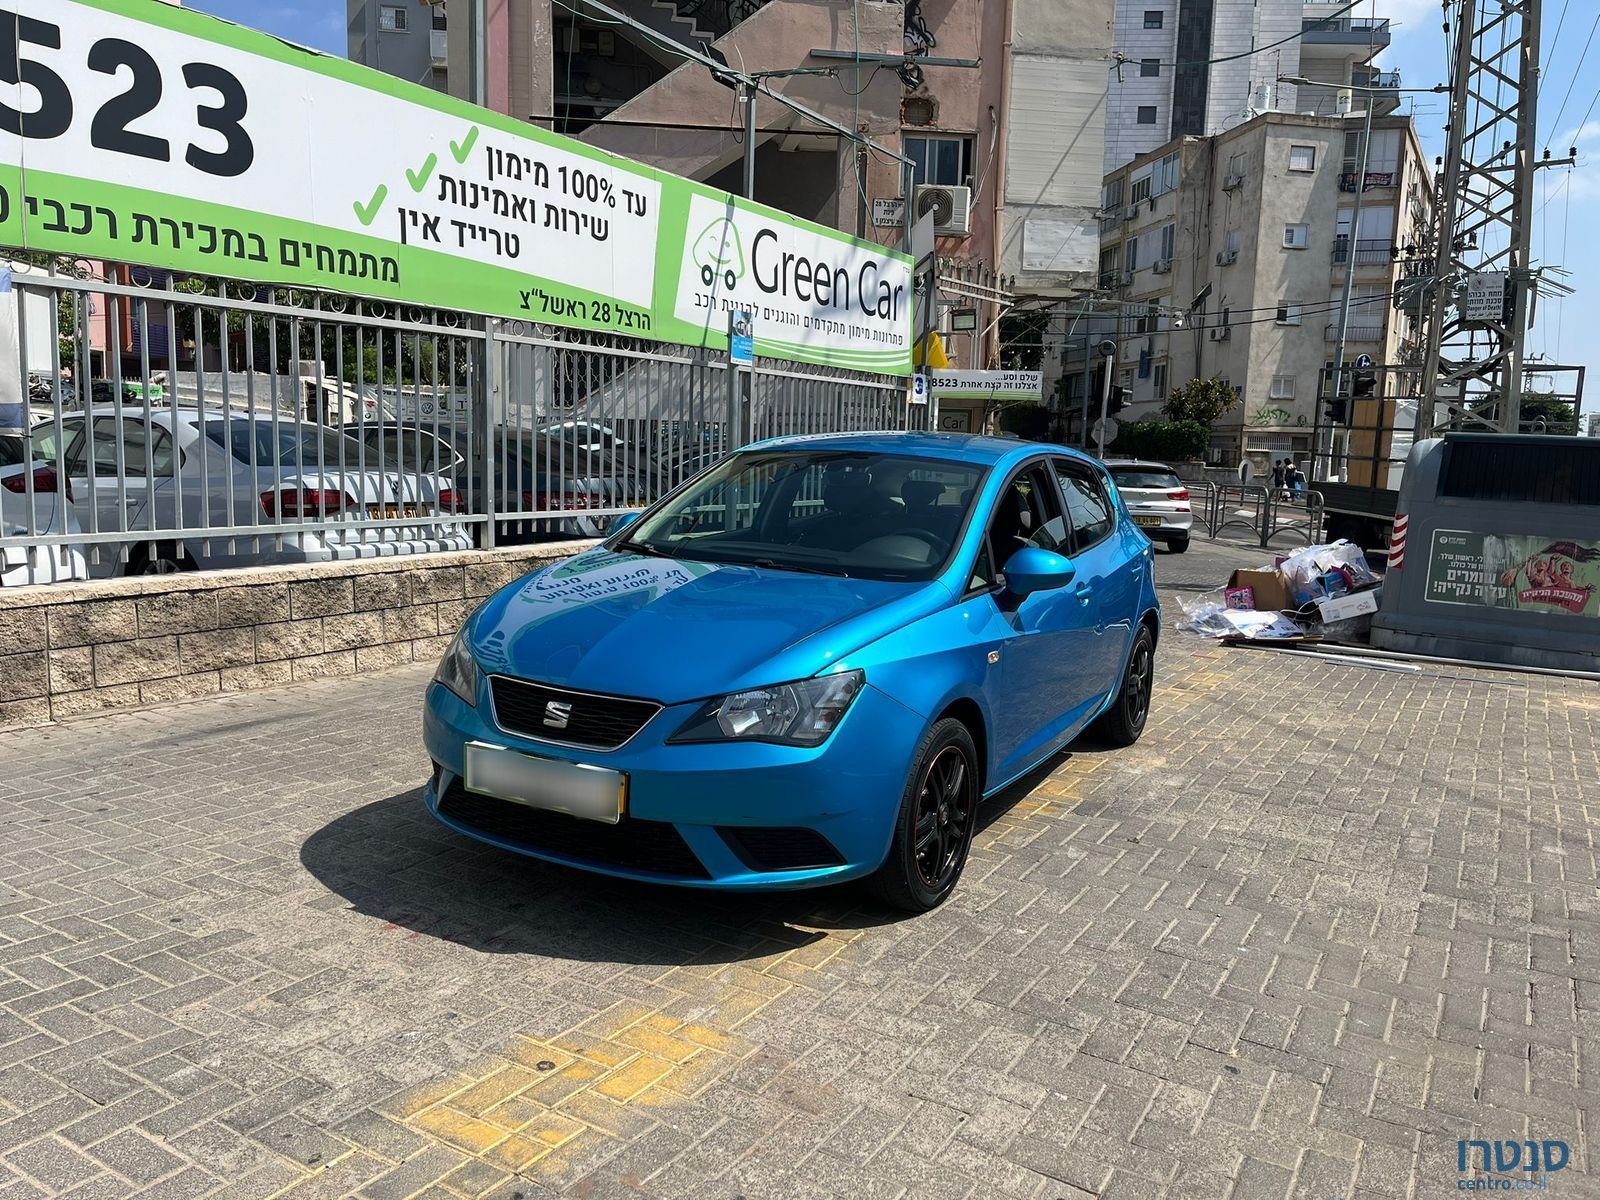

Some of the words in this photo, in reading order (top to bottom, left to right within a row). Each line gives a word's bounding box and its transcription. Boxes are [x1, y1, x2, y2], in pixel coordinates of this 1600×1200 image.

[486, 146, 549, 188] מימון
[558, 166, 616, 209] 100%
[438, 174, 536, 224] ואמינות
[621, 189, 647, 217] עד
[25, 194, 118, 239] רכבי
[397, 207, 441, 245] אין
[543, 203, 609, 241] שירות
[131, 212, 269, 262] במכירת
[450, 219, 520, 258] טרייד
[279, 238, 399, 283] מתמחים
[751, 228, 849, 311] Green
[858, 260, 904, 322] Car
[591, 300, 611, 324] 28
[694, 292, 717, 310] רכב
[615, 303, 651, 331] הרצל
[763, 307, 800, 326] והוגנים
[803, 315, 845, 335] מתקדמים
[848, 324, 870, 339] מימון
[872, 329, 903, 346] פתרונות
[960, 381, 983, 389] אחרת
[984, 381, 1002, 390] קצת
[1003, 381, 1013, 389] זה
[1014, 382, 1038, 390] אצלנו
[1019, 373, 1038, 381] שלם
[942, 416, 964, 430] Car
[1447, 569, 1497, 584] שומרים
[1433, 581, 1471, 597] נקייה!
